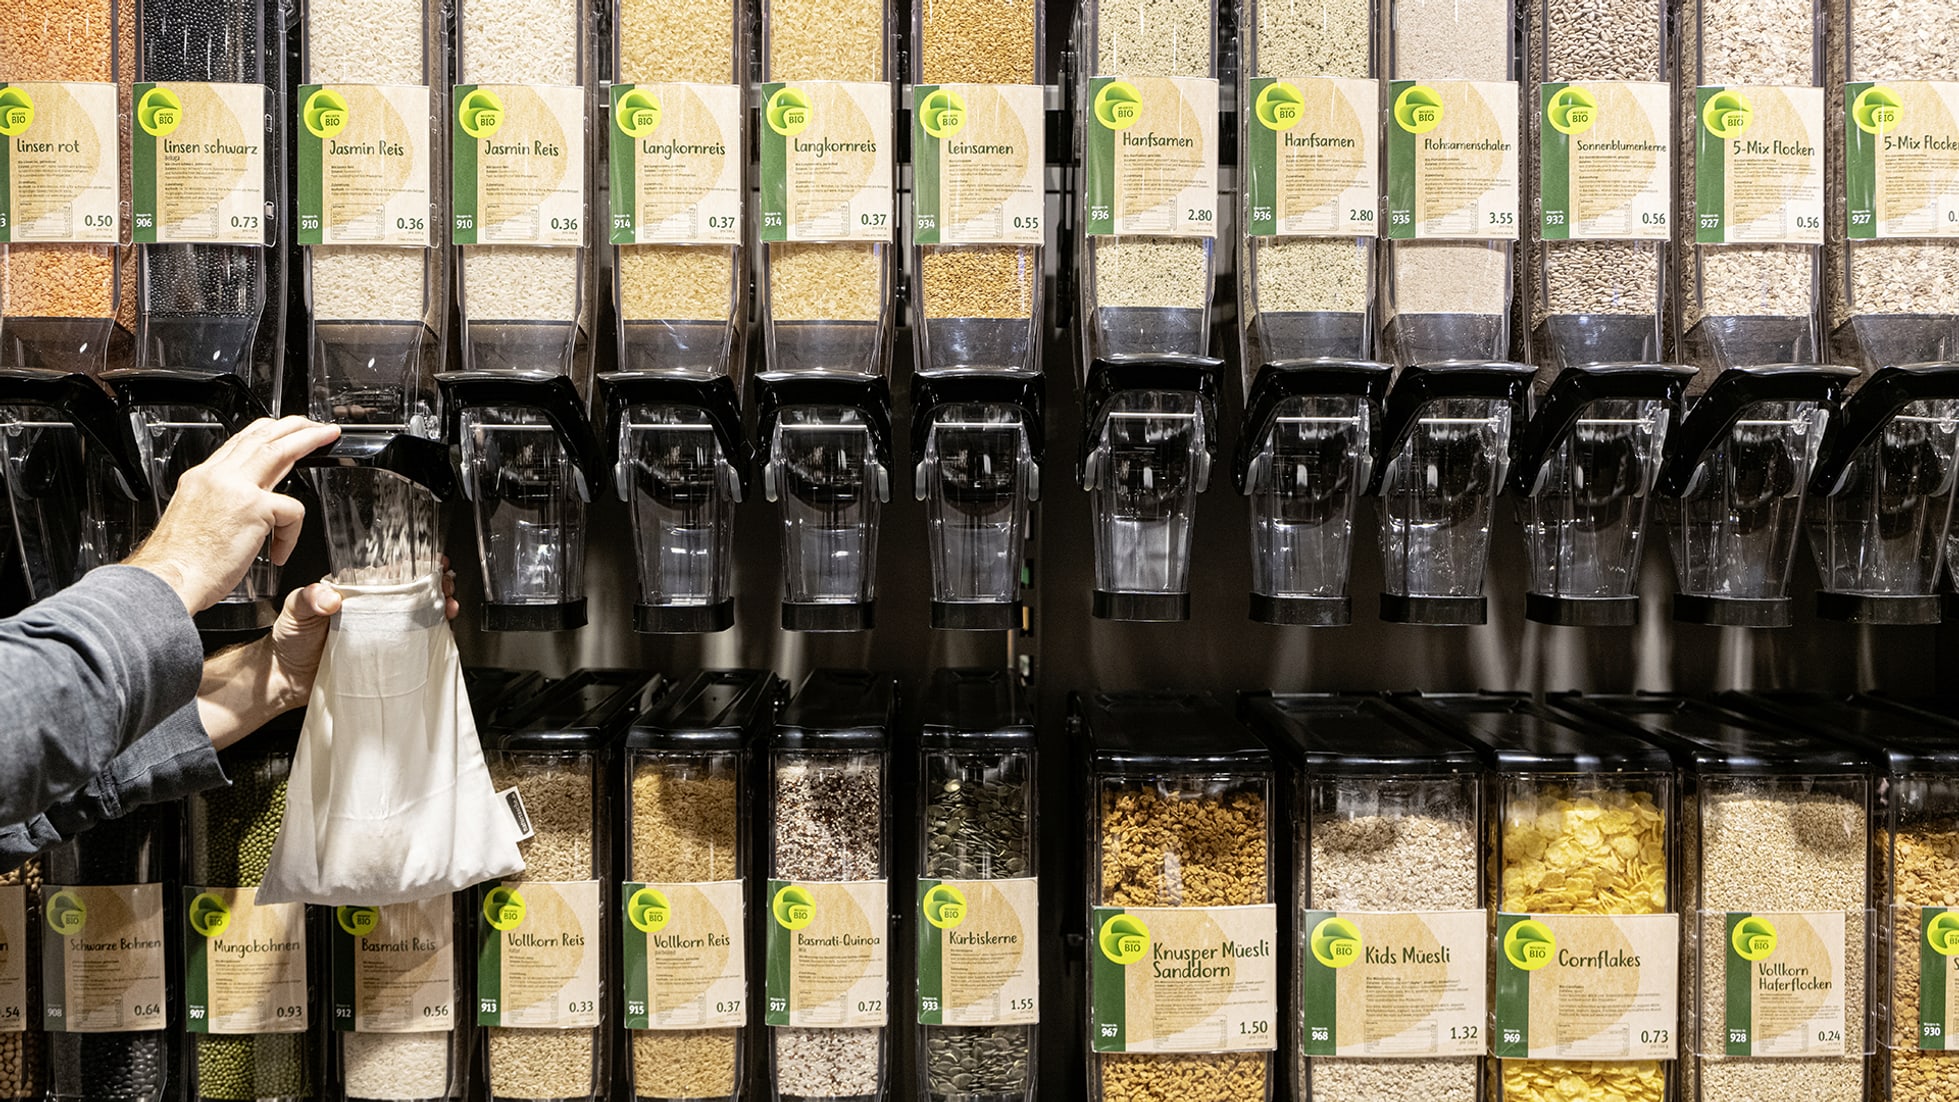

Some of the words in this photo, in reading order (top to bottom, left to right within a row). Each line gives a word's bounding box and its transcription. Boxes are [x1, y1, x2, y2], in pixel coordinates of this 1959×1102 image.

[12, 116, 26, 124] BIO
[159, 116, 173, 124] BIO
[789, 116, 804, 124] BIO
[1280, 110, 1295, 118] BIO
[1418, 114, 1434, 122] BIO
[1572, 114, 1588, 122] BIO
[326, 118, 340, 126] BIO
[480, 118, 495, 126] BIO
[638, 117, 653, 125] BIO
[942, 118, 958, 126] BIO
[1123, 132, 1193, 147] Hanfsamen
[1285, 132, 1354, 148] Hanfsamen
[1425, 138, 1512, 151] Flohsamenschalen
[1884, 136, 1920, 150] 5-Mix
[58, 140, 79, 153] rot
[204, 138, 257, 154] schwarz
[330, 140, 374, 155] Jasmin
[379, 140, 404, 156] Reis
[484, 140, 530, 155] Jasmin
[534, 140, 559, 156] Reis
[1577, 140, 1666, 152] Sonnenblumenkerne
[1734, 140, 1769, 155] 5-Mix
[1774, 140, 1814, 156] Flocken
[85, 215, 112, 227] 0.50
[861, 214, 886, 226] 0.37
[1092, 210, 1109, 220] 936
[1188, 209, 1212, 221] 2.80
[1253, 210, 1271, 220] 936
[1350, 209, 1373, 221] 2.80
[1393, 214, 1410, 224] 935
[1490, 212, 1513, 224] 3.55
[1546, 215, 1564, 224] 932
[1642, 212, 1666, 224] 0.56
[1852, 214, 1871, 224] 927
[136, 218, 152, 227] 906
[231, 216, 258, 228] 0.73
[302, 220, 318, 229] 910
[397, 218, 424, 230] 0.36
[456, 220, 472, 229] 910
[551, 218, 578, 230] 0.36
[614, 219, 630, 228] 914
[709, 216, 735, 228] 0.37
[765, 217, 782, 226] 914
[918, 219, 935, 229] 934
[1014, 217, 1038, 229] 0.55
[1701, 219, 1719, 228] 927
[1797, 216, 1819, 228] 0.56
[66, 917, 80, 925] BIO
[794, 912, 808, 920] BIO
[508, 933, 558, 947] Vollkorn
[562, 933, 584, 946] Reis
[654, 934, 704, 948] Vollkorn
[708, 933, 730, 946] Reis
[798, 933, 880, 946] Basmati-Quinoa
[950, 931, 1017, 944] Kürbiskerne
[71, 939, 117, 951] Schwarze
[120, 937, 160, 951] Bohnen
[214, 938, 300, 957] Mungobohnen
[362, 937, 408, 952] Basmati
[412, 937, 435, 952] Reis
[1124, 944, 1140, 952] BIO
[1153, 942, 1218, 966] Knusper
[1222, 940, 1269, 958] Müesli
[1336, 947, 1352, 955] BIO
[1366, 946, 1396, 964] Kids
[1403, 946, 1450, 964] Müesli
[1530, 950, 1546, 958] BIO
[1559, 949, 1640, 968] Cornflakes
[1153, 960, 1230, 978] Sanddorn
[1759, 962, 1808, 976] Vollkorn
[1759, 976, 1832, 992] Haferflocken
[134, 1004, 160, 1016] 0.64
[481, 1003, 496, 1012] 913
[569, 1001, 593, 1012] 0.33
[629, 1005, 644, 1014] 915
[716, 1001, 740, 1012] 0.37
[770, 1002, 786, 1011] 917
[858, 1000, 881, 1012] 0.72
[922, 1001, 938, 1010] 933
[1011, 998, 1033, 1010] 1.55
[1, 1006, 20, 1018] .54
[48, 1008, 62, 1017] 908
[190, 1009, 204, 1018] 907
[277, 1006, 302, 1018] 0.93
[336, 1008, 351, 1017] 912
[423, 1005, 448, 1017] 0.56
[1102, 1028, 1118, 1037] 967
[1240, 1020, 1268, 1034] 1.50
[1451, 1026, 1477, 1039] 1.32
[1924, 1027, 1940, 1036] 930
[1312, 1031, 1328, 1040] 968
[1504, 1033, 1520, 1043] 969
[1641, 1030, 1668, 1043] 0.73
[1730, 1033, 1746, 1042] 928
[1818, 1031, 1840, 1041] 0.24
